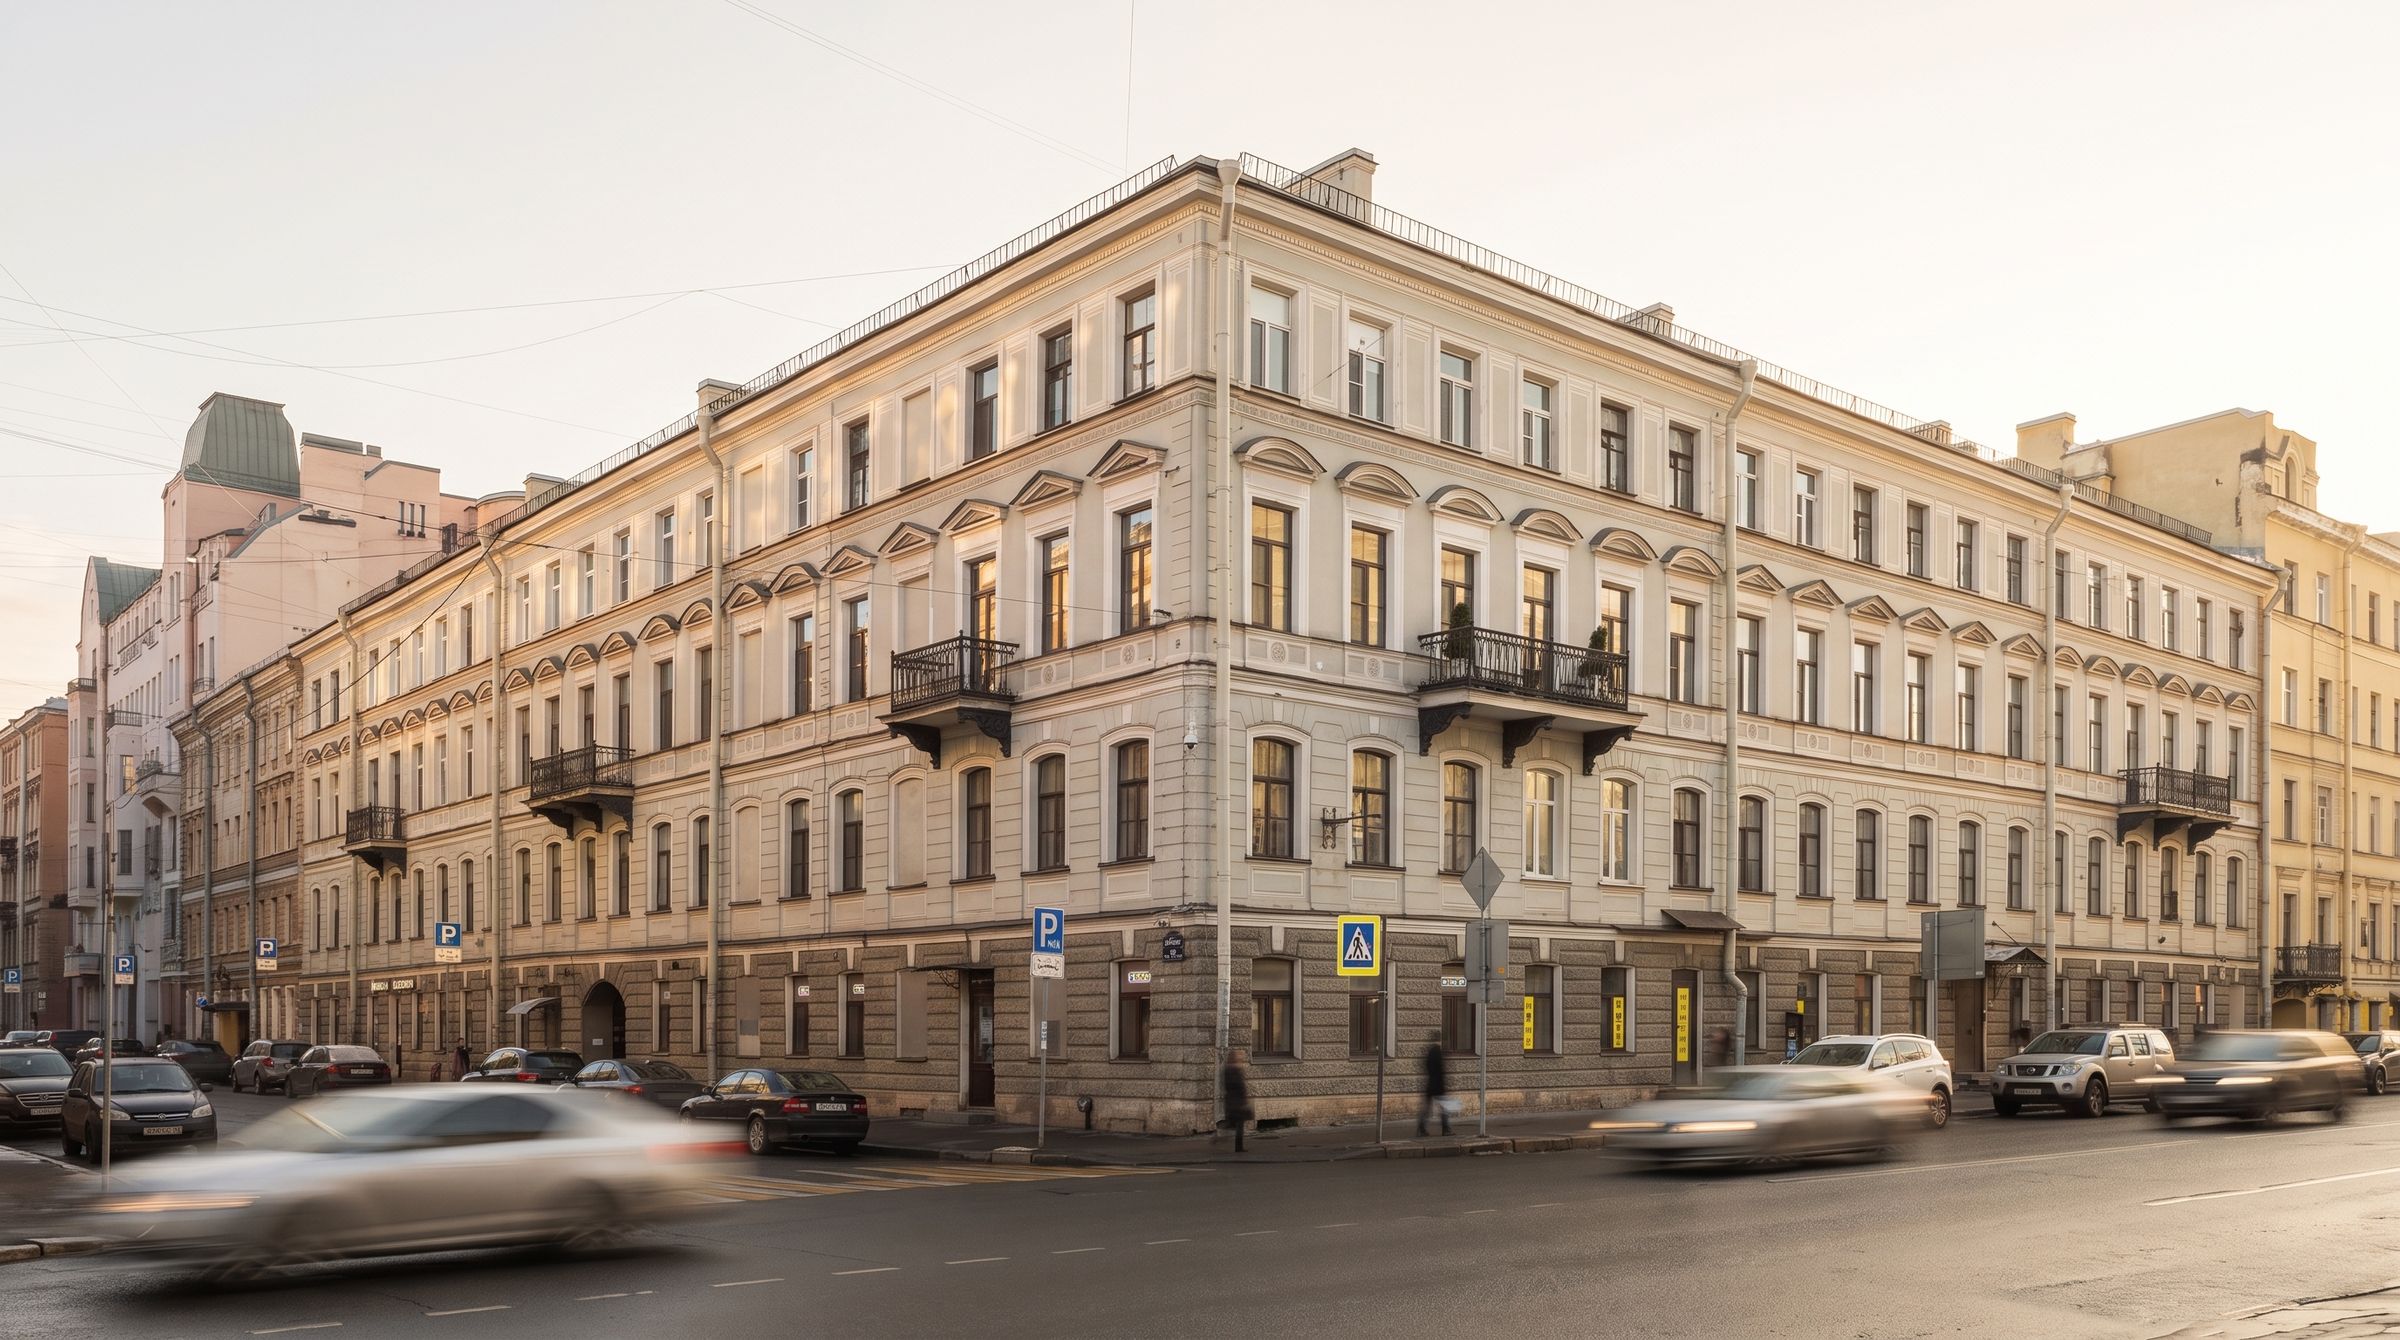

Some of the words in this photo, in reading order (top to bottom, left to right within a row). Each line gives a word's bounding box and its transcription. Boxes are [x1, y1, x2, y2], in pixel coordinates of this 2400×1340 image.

[442, 925, 457, 944] P
[1041, 912, 1058, 948] P
[260, 940, 274, 956] P
[118, 958, 130, 972] P
[8, 970, 18, 983] P
